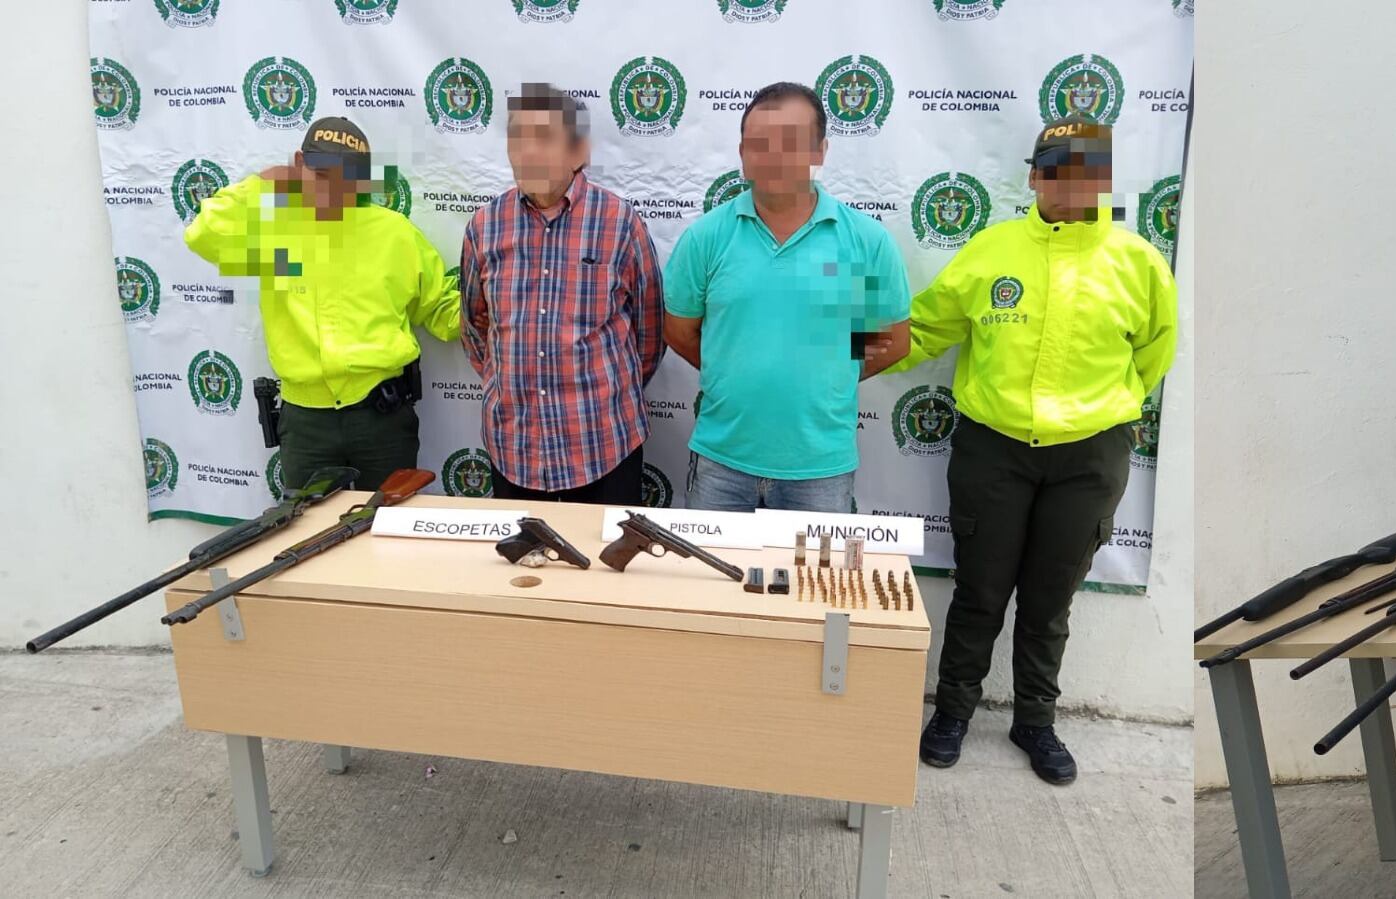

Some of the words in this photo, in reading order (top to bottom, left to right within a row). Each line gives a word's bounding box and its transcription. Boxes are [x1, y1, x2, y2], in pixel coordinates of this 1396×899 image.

[154, 87, 191, 96] POLICÍA
[194, 86, 237, 94] NACIONAL
[333, 87, 367, 96] POLICÍA
[369, 88, 415, 96] NACIONAL
[700, 89, 741, 99] POLICÍA
[909, 88, 953, 99] POLICÍA
[957, 91, 1017, 99] NACIONAL
[1139, 89, 1185, 99] POLICÍA
[169, 99, 180, 107] DE
[183, 97, 226, 106] COLOMBIA
[922, 103, 937, 112] DE
[940, 103, 1000, 112] COLOMBIA
[424, 193, 458, 201] POLICÍA
[643, 200, 695, 208] NACIONAL
[172, 284, 204, 292] POLICÍA
[135, 373, 182, 381] NACIONAL
[188, 464, 215, 473] POLICÍA
[217, 468, 260, 477] NACIONAL
[209, 476, 249, 486] COLOMBIA
[413, 520, 511, 536] ESCOPETAS
[670, 523, 722, 535] PISTOLA
[807, 524, 899, 543] MUNICIÓN
